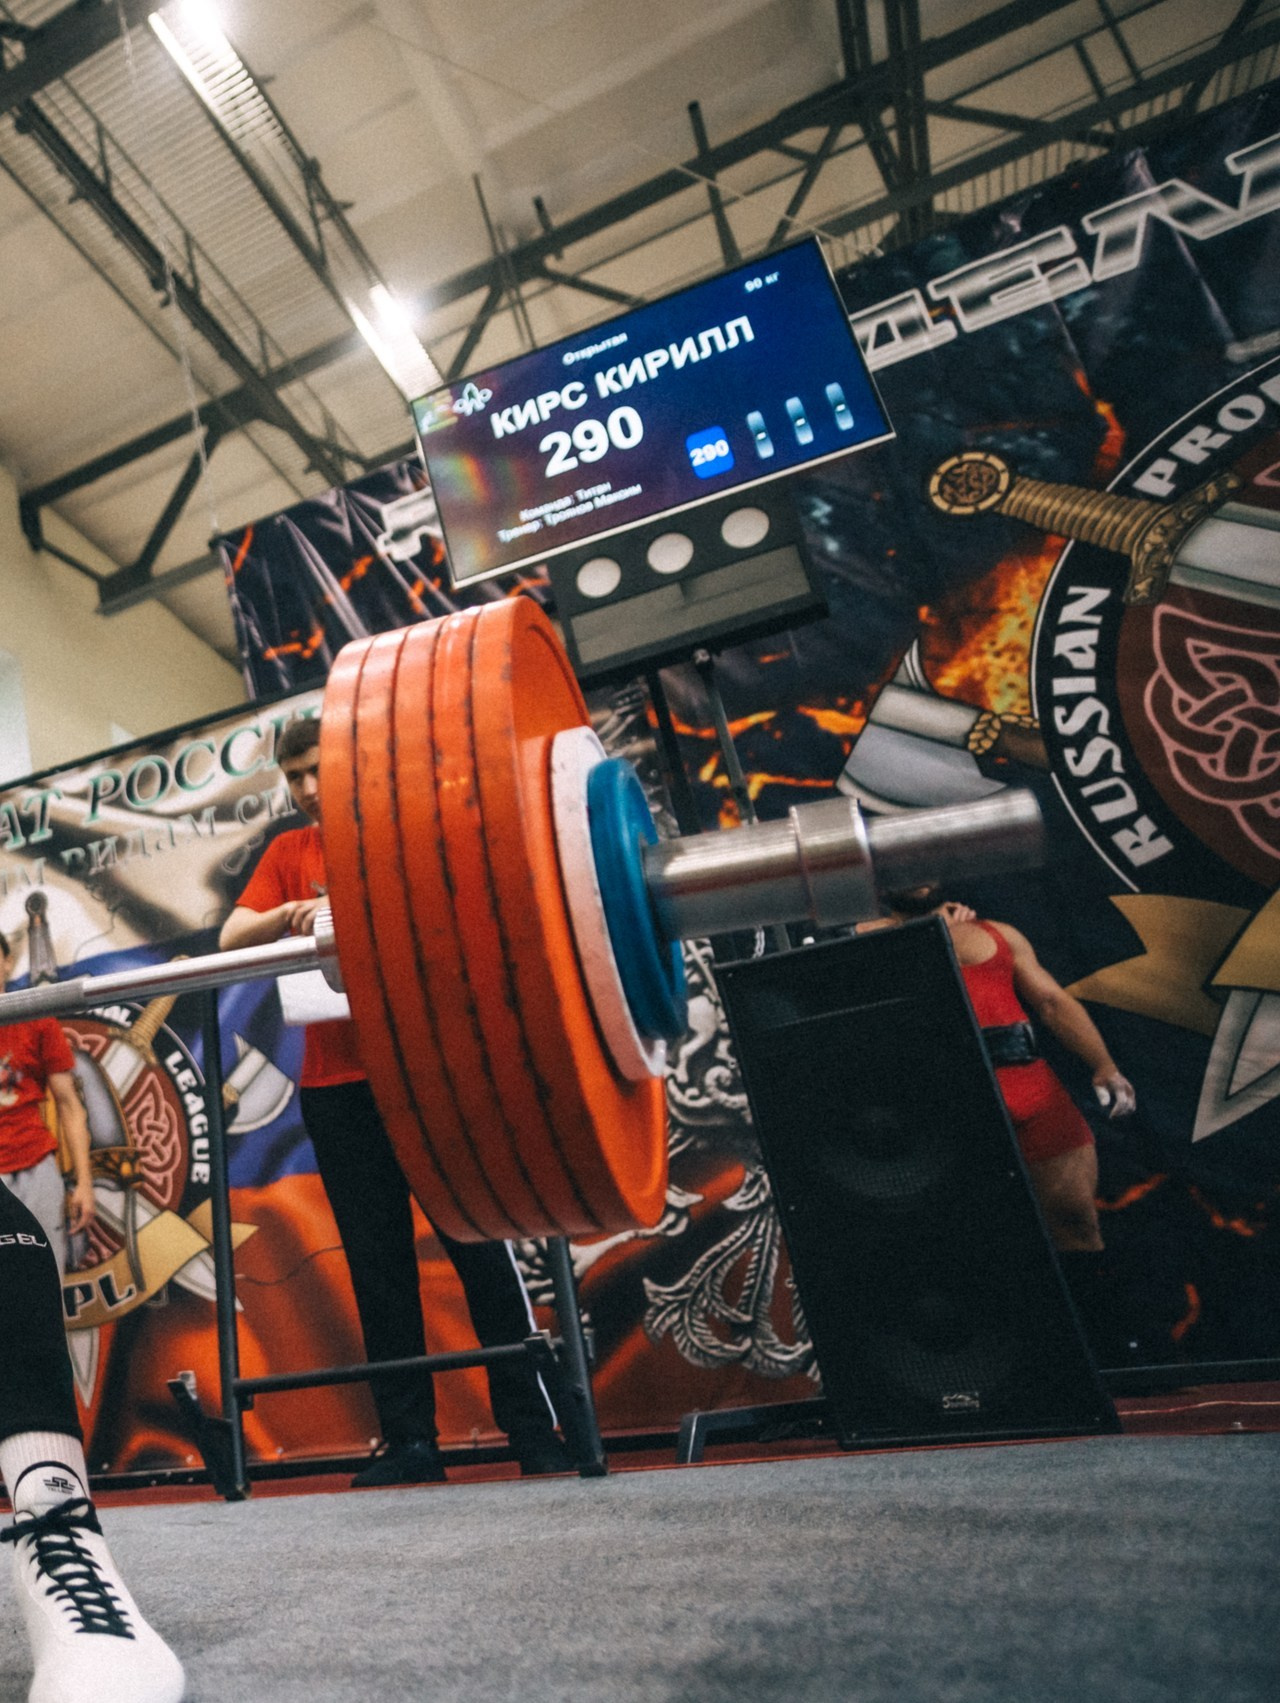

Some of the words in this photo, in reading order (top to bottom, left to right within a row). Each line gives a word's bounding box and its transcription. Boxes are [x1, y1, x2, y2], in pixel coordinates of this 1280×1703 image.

[490, 381, 588, 439] КИРС
[595, 315, 755, 399] КИРИЛЛ
[1132, 373, 1280, 498] PRO
[539, 405, 644, 478] 290
[689, 439, 730, 467] 290
[1052, 585, 1174, 868] RUSSIAN
[165, 1051, 211, 1184] LEAGUE
